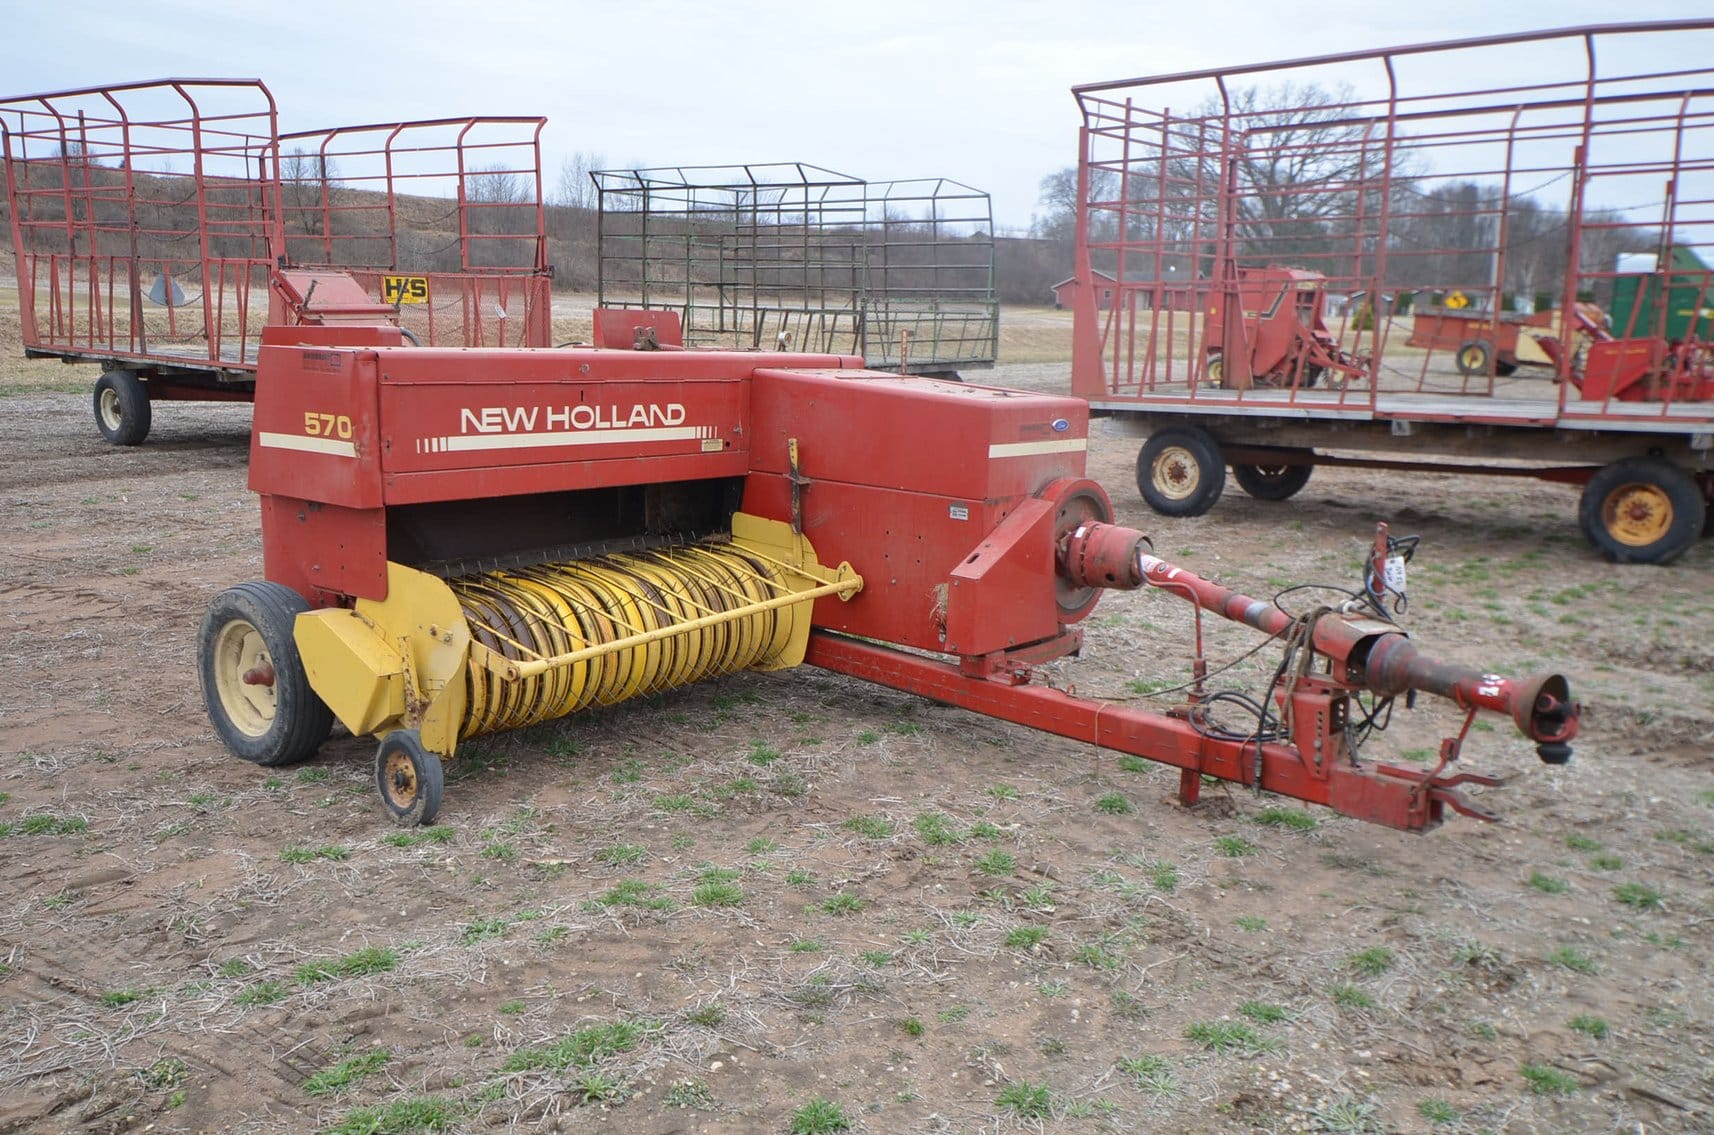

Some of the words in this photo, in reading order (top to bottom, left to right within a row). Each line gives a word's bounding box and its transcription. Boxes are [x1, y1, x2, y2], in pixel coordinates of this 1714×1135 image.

[304, 411, 352, 439] 570
[461, 406, 539, 433] NEW
[546, 403, 686, 430] HOLLAND
